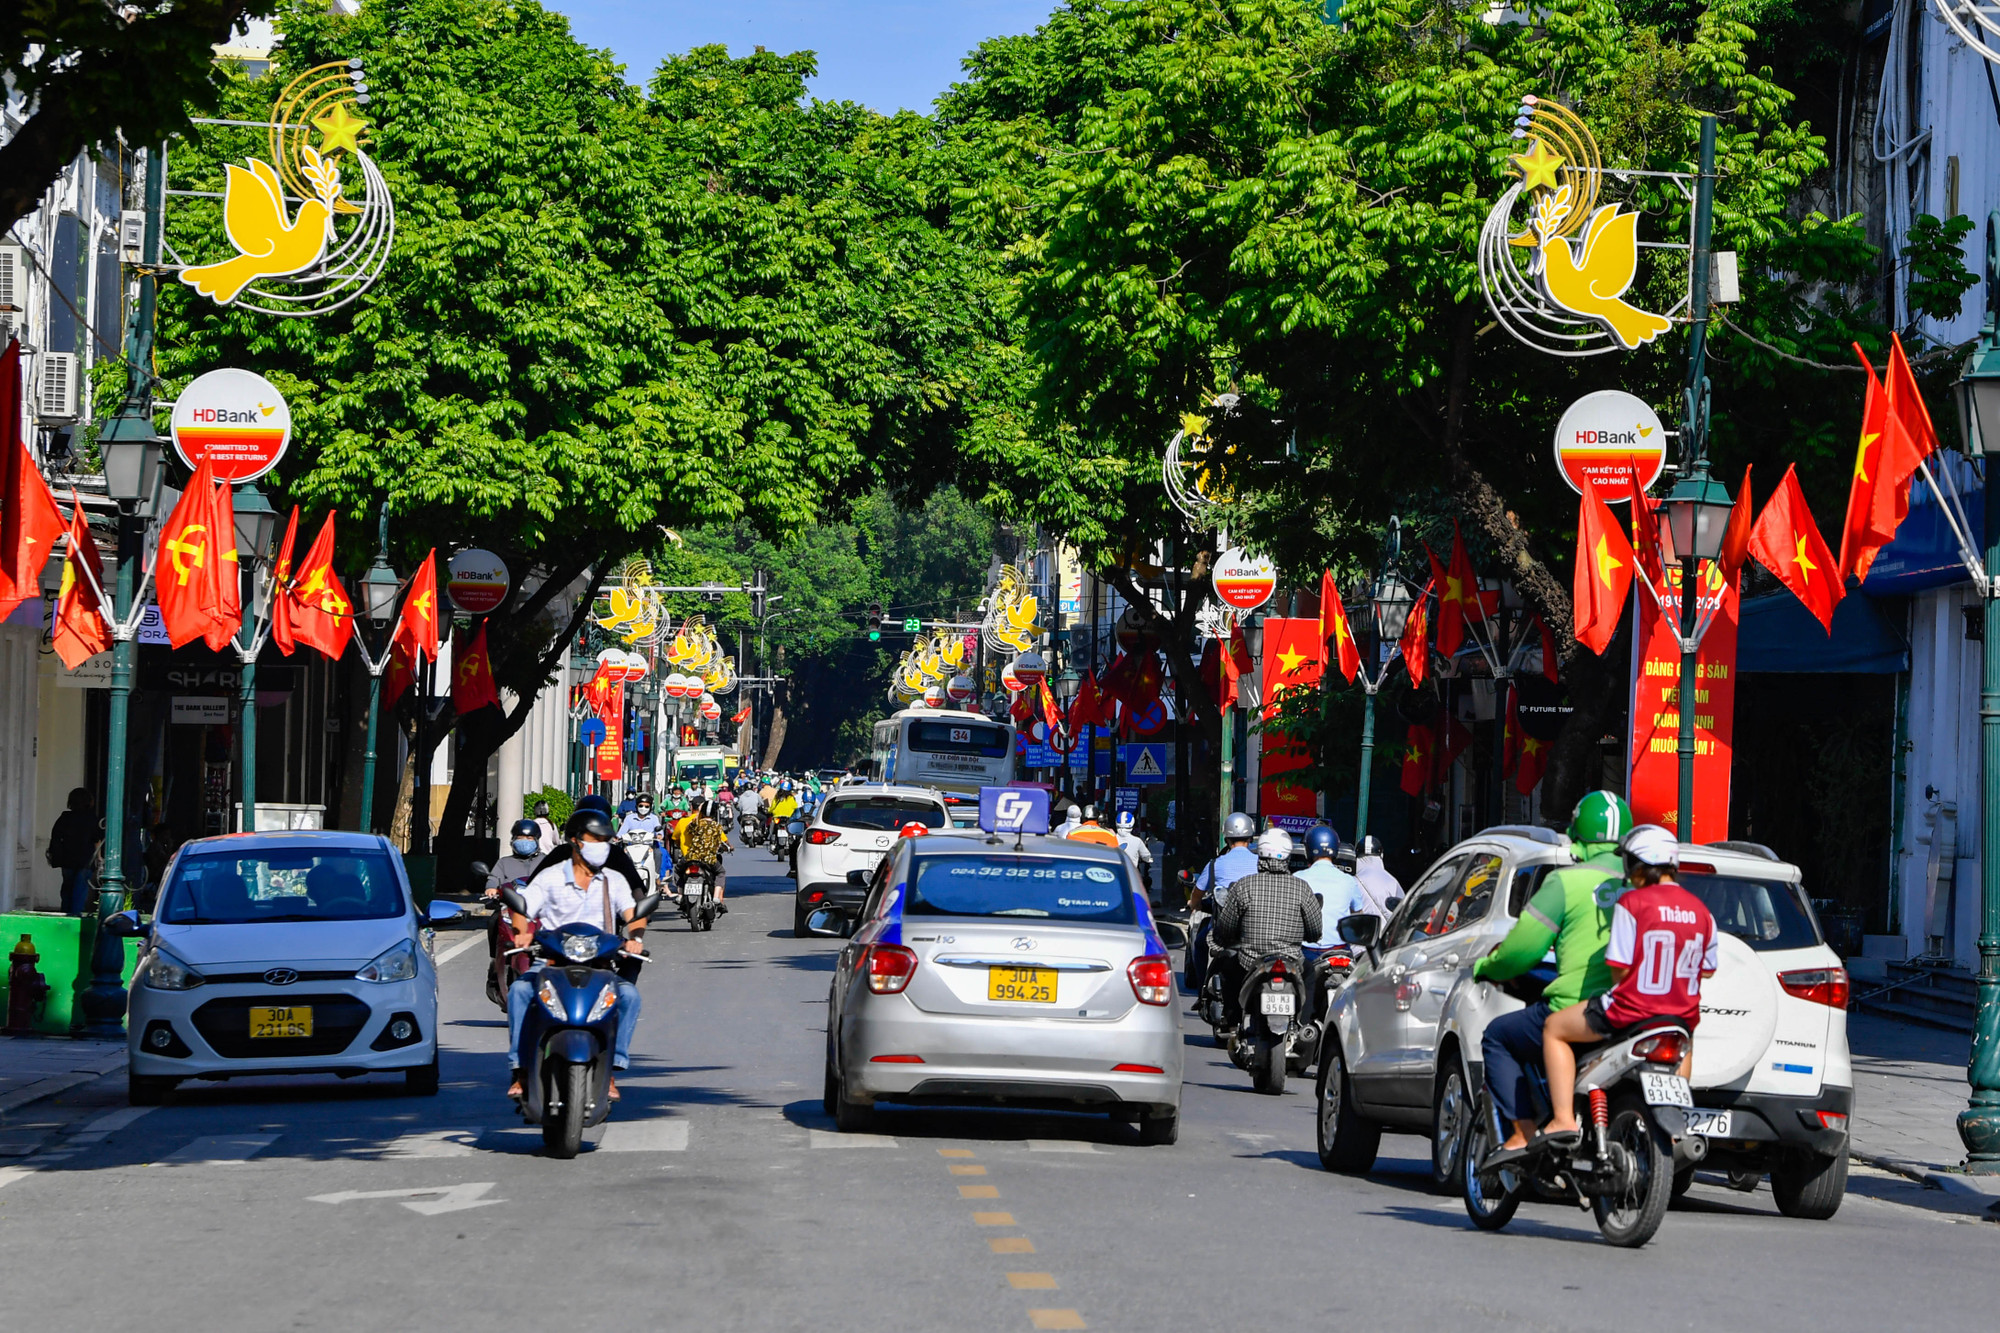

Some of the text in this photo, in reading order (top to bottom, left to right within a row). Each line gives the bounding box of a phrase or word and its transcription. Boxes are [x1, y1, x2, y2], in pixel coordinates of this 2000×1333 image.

[193, 408, 258, 423] HDBank
[1575, 430, 1636, 444] HDBank
[204, 443, 248, 451] COMMITTED
[216, 453, 235, 461] BEST
[1599, 466, 1613, 474] KẾT
[1614, 466, 1626, 475] LỢI
[1592, 476, 1629, 485] CAO NHẤT
[456, 571, 493, 580] HDBank
[1224, 568, 1259, 577] HDBank
[905, 619, 920, 631] 23
[1646, 656, 1674, 677] ĐẢNG
[1707, 659, 1728, 679] SẢN
[953, 730, 968, 741] 34
[995, 792, 1033, 828] G7
[978, 866, 1003, 877] 32
[1005, 867, 1030, 878] 32
[1033, 868, 1057, 879] 32
[1060, 869, 1084, 881] 32
[1088, 869, 1113, 880] 1138
[1658, 905, 1697, 924] Thảoo
[1636, 929, 1704, 996] 04
[1009, 968, 1038, 984] 30A
[996, 984, 1050, 1000] 994.25
[1265, 1004, 1290, 1013] 9569
[267, 1009, 294, 1022] 30A
[1775, 1039, 1816, 1049] TITANIUM
